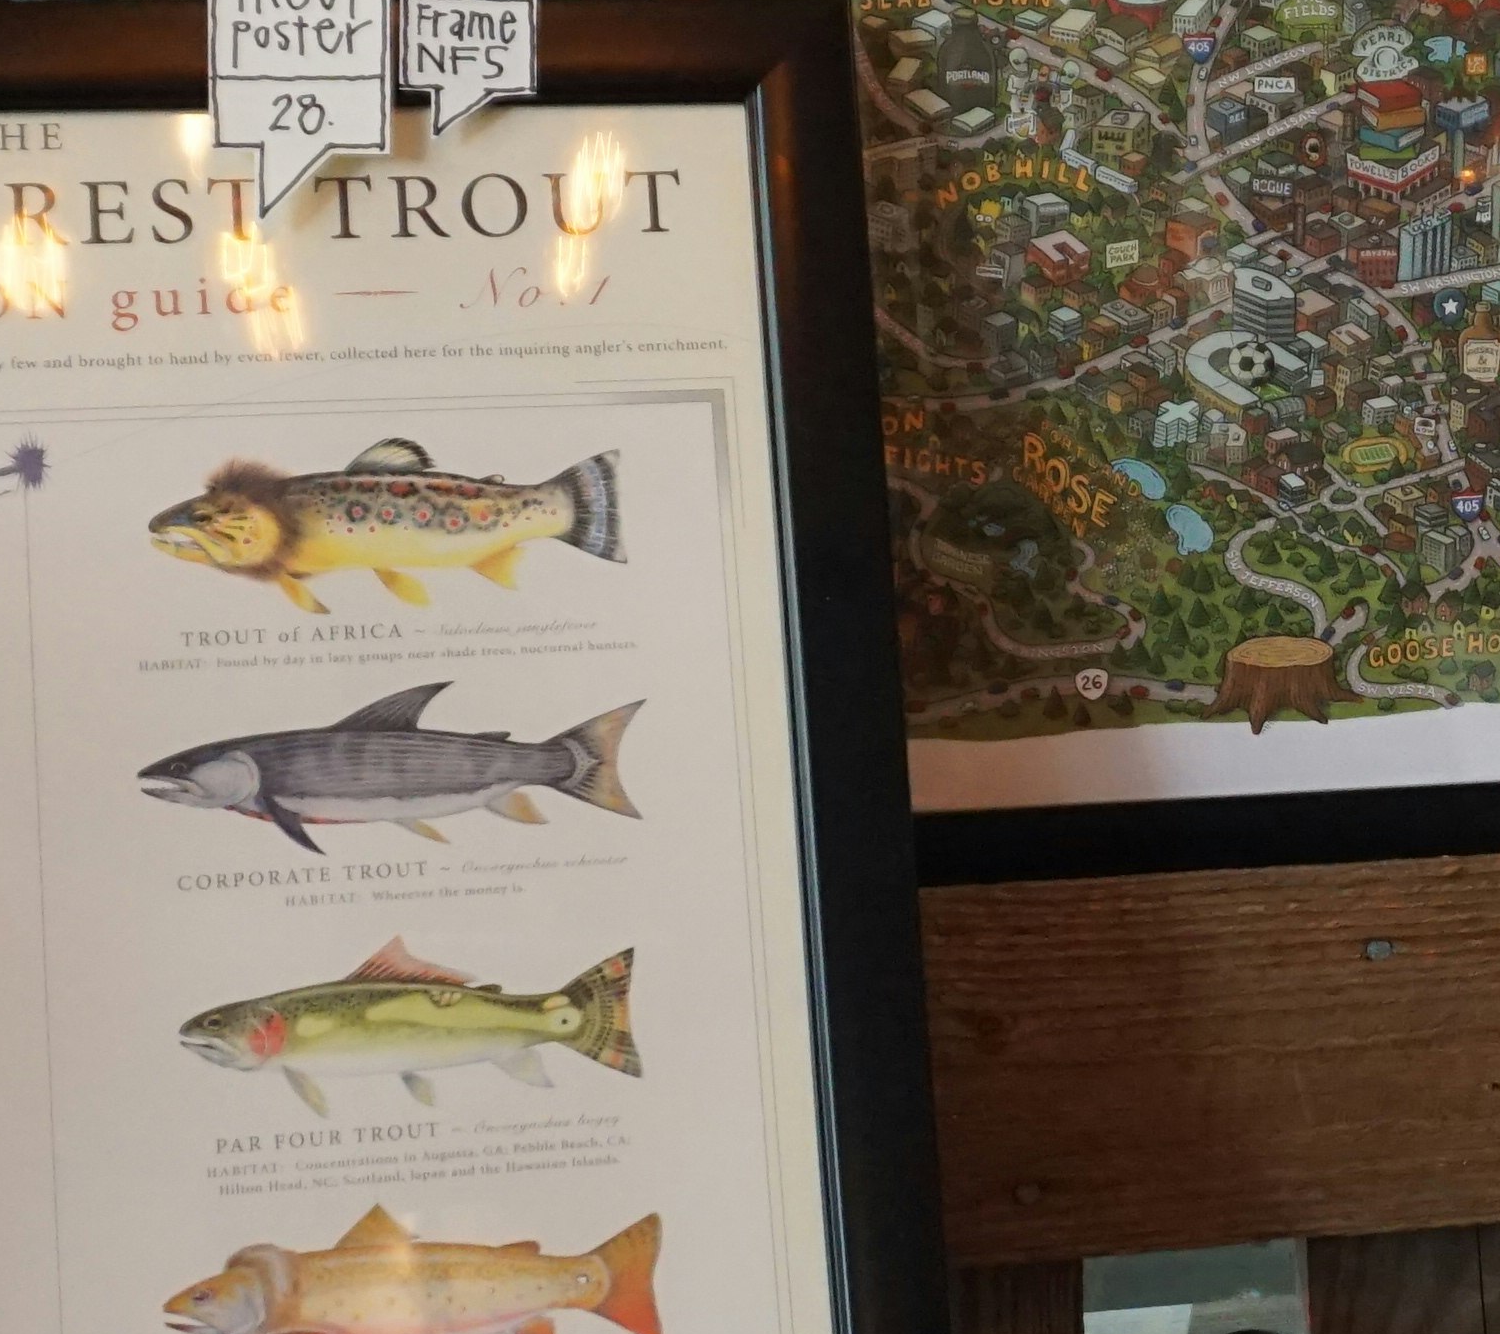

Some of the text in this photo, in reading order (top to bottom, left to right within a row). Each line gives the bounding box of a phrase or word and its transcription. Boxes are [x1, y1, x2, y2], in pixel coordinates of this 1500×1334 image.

[416, 3, 518, 45] Frame
[1283, 3, 1337, 19] FIELDS
[231, 16, 374, 69] poster
[416, 44, 511, 80] NFS
[945, 68, 990, 85] PORTLAND
[1256, 77, 1294, 92] PNCA
[936, 155, 1094, 209] NOB HILL
[1252, 178, 1292, 196] ROGUE
[313, 168, 681, 239] TROUT
[111, 277, 293, 332] guide
[10, 355, 37, 369] few
[43, 354, 72, 369] and
[77, 352, 142, 370] brought
[148, 352, 164, 366] to
[169, 350, 210, 366] hand
[214, 349, 231, 367] by
[237, 351, 273, 363] even
[279, 348, 325, 364] fewer,
[329, 346, 398, 361] collected
[403, 345, 436, 359] here
[441, 343, 464, 357] for
[468, 343, 495, 357] the
[500, 342, 570, 359] inquiring
[574, 339, 633, 356] angler's
[637, 337, 729, 353] enrichment.
[1022, 432, 1116, 528] ROSE
[1241, 569, 1321, 615] JEFFERSON
[179, 622, 403, 648] TROUT of AFRICA
[1368, 636, 1456, 668] GOOSE
[1081, 675, 1103, 690] 26
[1387, 684, 1437, 697] VISTA
[175, 860, 428, 892] CORPORATE TROUT
[214, 1121, 441, 1156] PAR FOUR TROUT
